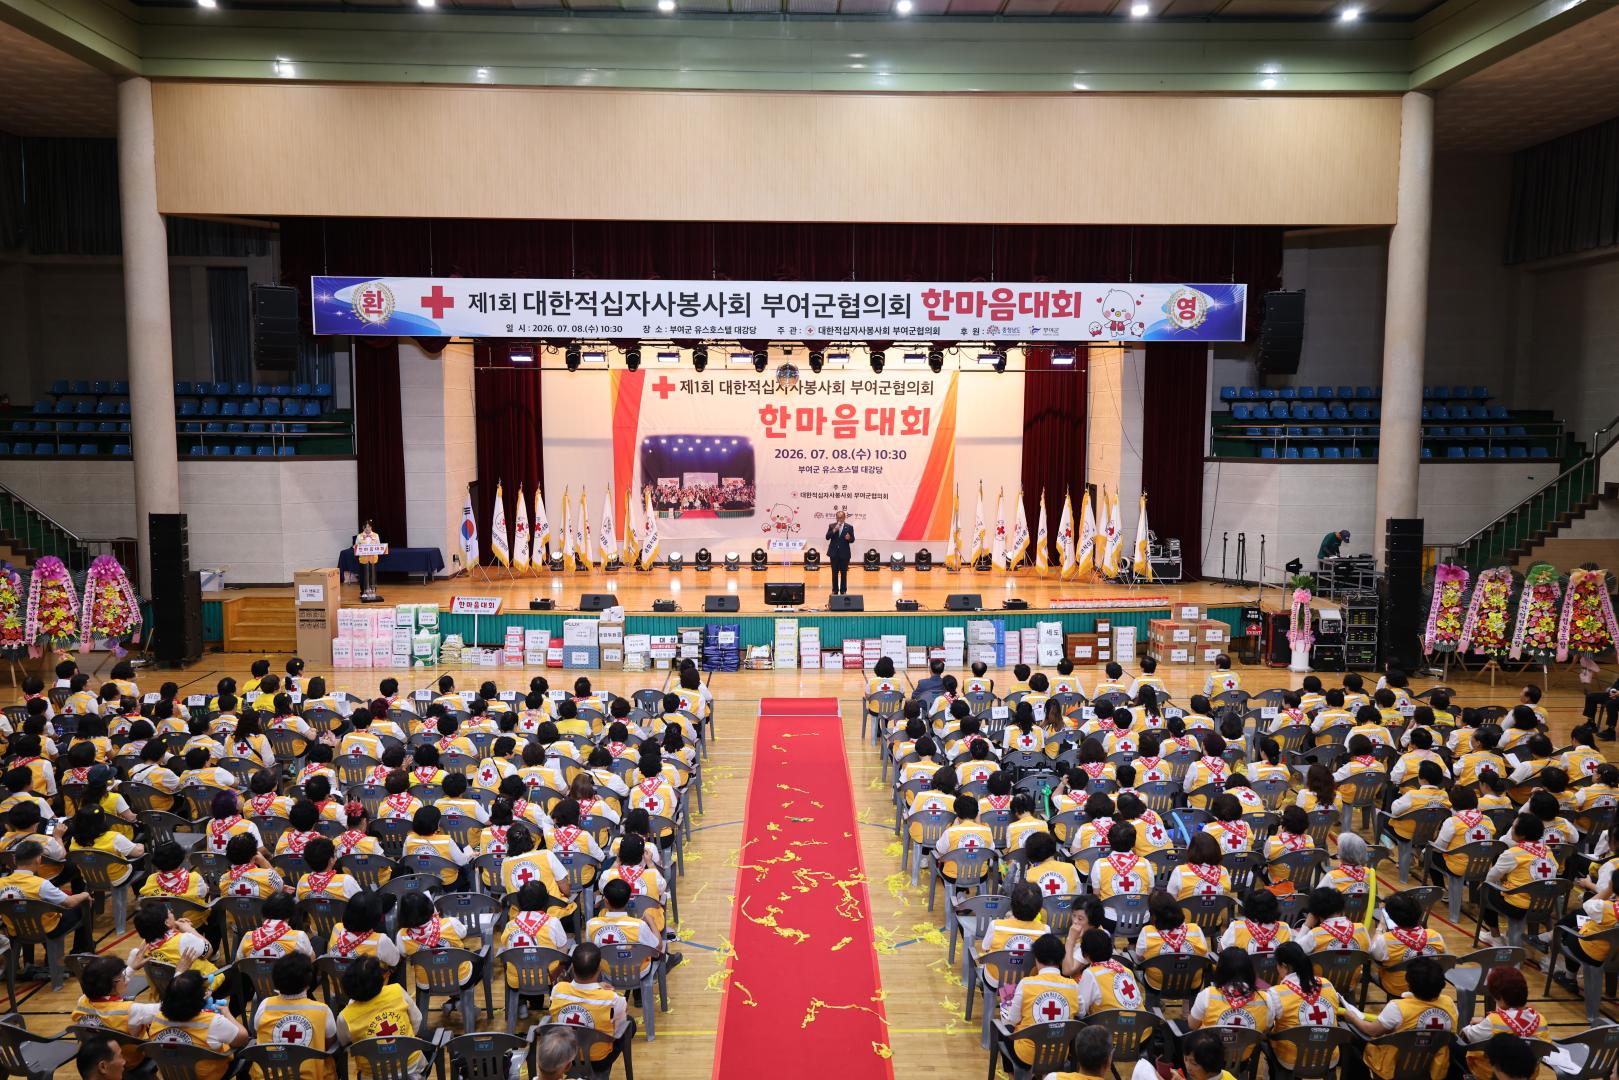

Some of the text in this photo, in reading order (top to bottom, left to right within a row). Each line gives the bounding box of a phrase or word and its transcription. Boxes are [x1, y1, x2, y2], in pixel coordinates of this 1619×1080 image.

[362, 290, 385, 315] 환
[468, 287, 1082, 321] 제1회 대한적십자사봉사회 부여군협의회 한마음대회
[1176, 296, 1196, 321] 영
[505, 323, 514, 332] 일
[601, 325, 623, 333] 10:30
[669, 325, 692, 334] 부여군
[694, 325, 733, 335] 유스호스텔
[734, 325, 757, 335] 대강당
[818, 326, 890, 336] 대한적십자사봉사회
[892, 326, 941, 336] 부여군협의회
[680, 380, 714, 395] 제1회
[850, 380, 934, 396] 부여군협의회
[758, 403, 931, 439] 한마음대회
[774, 448, 807, 460] 2026.
[810, 449, 828, 460] 07.
[875, 450, 907, 460] 10:30
[798, 465, 883, 475] 부여군 유스호스텔 대강당
